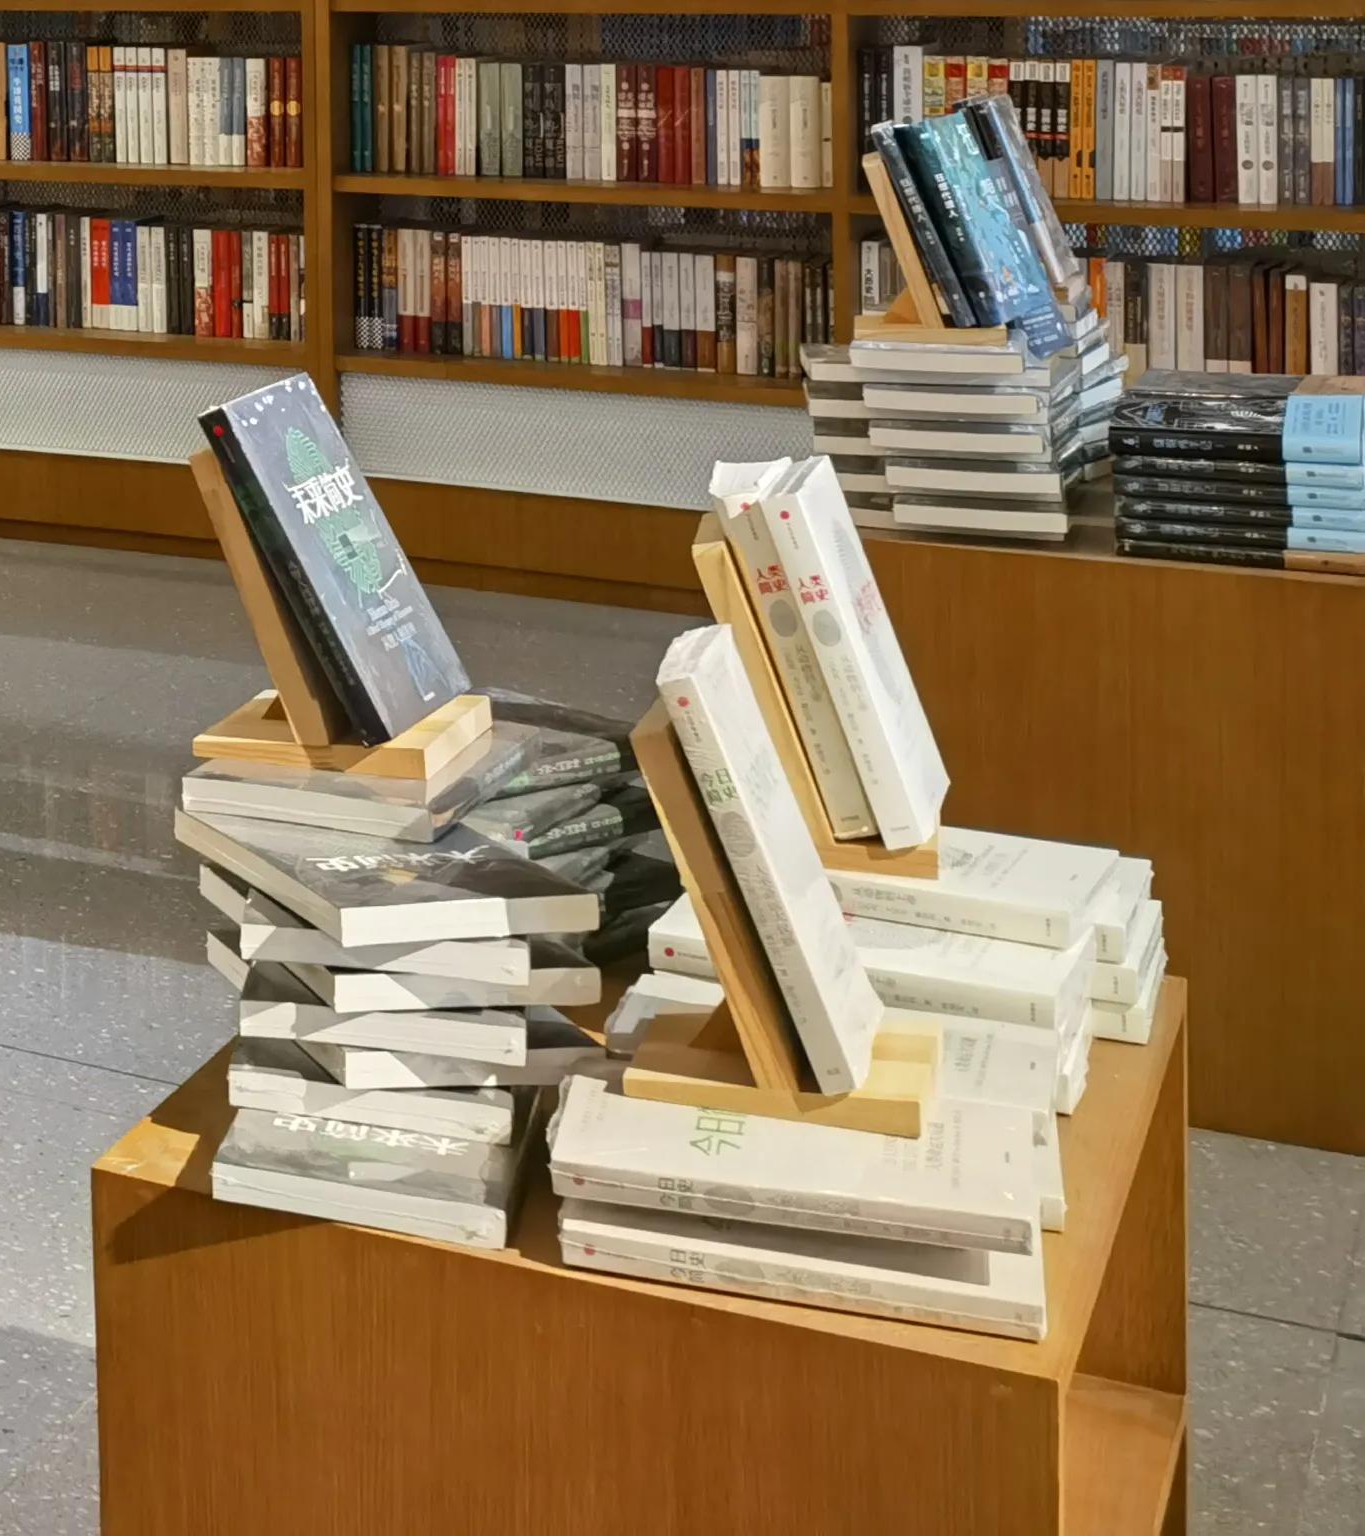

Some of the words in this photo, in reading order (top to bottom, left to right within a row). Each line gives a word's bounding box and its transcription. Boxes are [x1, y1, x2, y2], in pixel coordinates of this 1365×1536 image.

[282, 456, 364, 525] 未来简史
[757, 563, 783, 582] 人类
[758, 577, 789, 597] 简史
[798, 574, 823, 593] 人类
[800, 587, 829, 605] 简史
[700, 767, 730, 788] 今日
[705, 784, 738, 805] 简史
[273, 1114, 470, 1156] 未来简史
[690, 1104, 747, 1156] 今日
